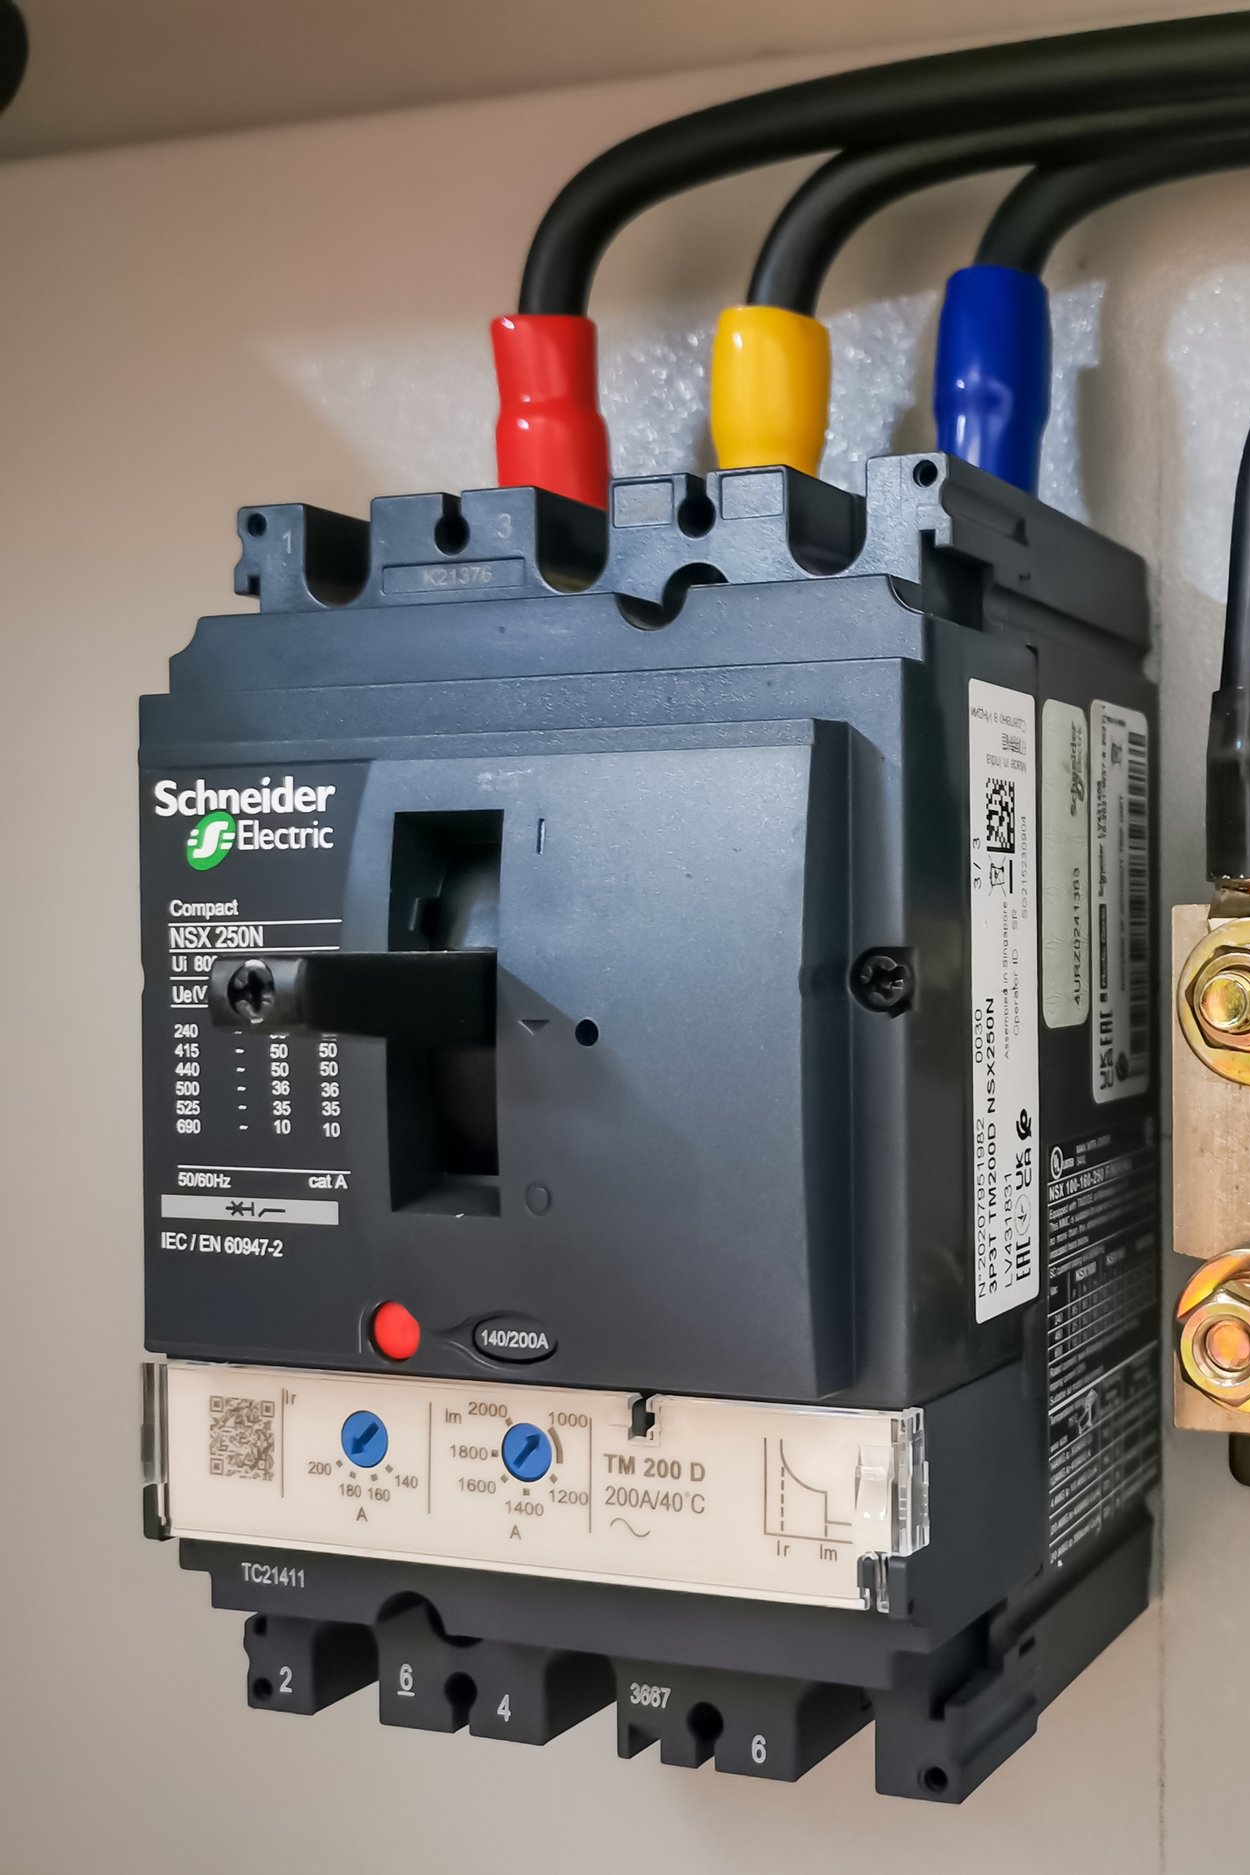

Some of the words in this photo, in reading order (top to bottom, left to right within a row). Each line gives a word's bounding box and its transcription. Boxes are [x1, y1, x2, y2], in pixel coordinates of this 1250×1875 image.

[154, 776, 336, 816] Schneider
[237, 820, 334, 850] Electric
[169, 898, 239, 920] Compact
[169, 927, 211, 949] NSX
[215, 925, 264, 948] 250N
[1001, 901, 1009, 968] Singapore
[172, 955, 187, 972] Ui
[174, 1024, 198, 1038] 240
[974, 1009, 983, 1064] 0030
[174, 1043, 200, 1058] 415
[269, 1043, 289, 1059] 50
[318, 1042, 338, 1058] 50
[985, 997, 996, 1114] NSX250N
[175, 1062, 200, 1077] 440
[270, 1062, 290, 1077] 50
[319, 1061, 339, 1077] 50
[175, 1081, 200, 1096] 500
[271, 1080, 291, 1096] 36
[321, 1082, 340, 1098] 36
[176, 1100, 201, 1115] 525
[272, 1100, 291, 1116] 35
[321, 1101, 341, 1116] 35
[176, 1119, 201, 1134] 690
[273, 1120, 291, 1135] 10
[322, 1122, 341, 1137] 10
[177, 1172, 232, 1189] 50/60Hz
[988, 1122, 997, 1224] TM200D
[308, 1175, 332, 1189] cat
[334, 1175, 349, 1190] A
[1004, 1173, 1013, 1288] LV431831
[161, 1231, 188, 1251] IEC
[199, 1235, 221, 1253] EN
[224, 1236, 284, 1258] 60947-2
[988, 1233, 997, 1293] 3P3T
[481, 1329, 549, 1349] 140/200A
[468, 1401, 509, 1418] 2000
[548, 1411, 588, 1429] 1000
[449, 1445, 488, 1461] 1800
[307, 1460, 332, 1477] 200
[603, 1453, 637, 1476] TM
[643, 1458, 682, 1479] 200
[690, 1462, 706, 1482] D
[339, 1484, 362, 1498] 180
[394, 1474, 419, 1490] 140
[458, 1478, 497, 1495] 1600
[367, 1487, 391, 1503] 160
[548, 1489, 589, 1506] 1200
[356, 1506, 369, 1522] A
[504, 1500, 545, 1517] 1400
[509, 1525, 522, 1540] A
[241, 1562, 305, 1588] TC21411
[279, 1666, 294, 1694] 2
[400, 1663, 414, 1692] 6
[496, 1694, 512, 1722] 4
[751, 1734, 768, 1764] 6
